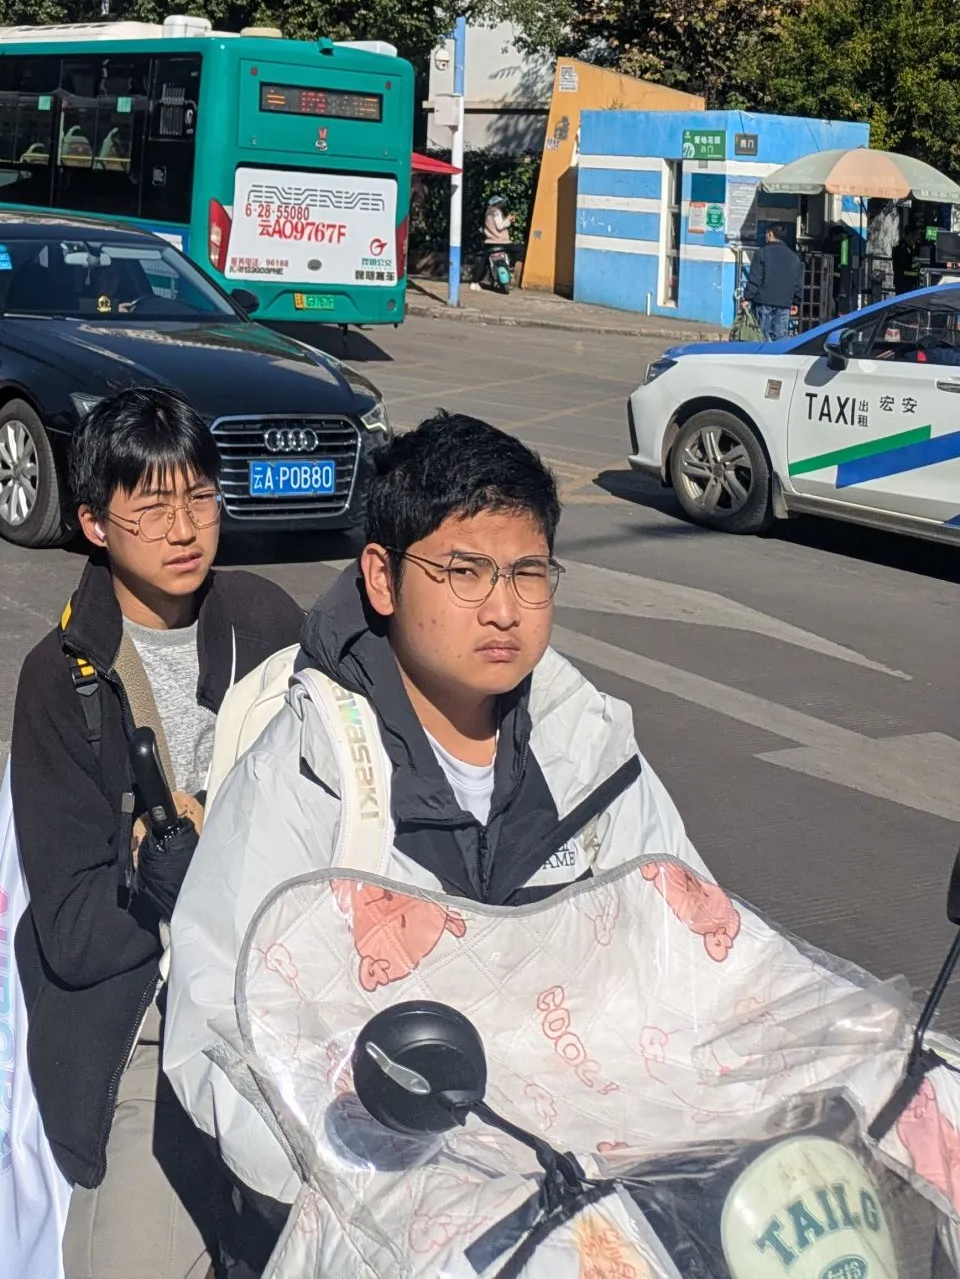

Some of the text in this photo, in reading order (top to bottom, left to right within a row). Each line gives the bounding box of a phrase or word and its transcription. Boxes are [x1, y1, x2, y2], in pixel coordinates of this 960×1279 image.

[805, 392, 857, 426] TAXI
[857, 399, 870, 428] 出租
[879, 395, 918, 414] 宏安
[752, 1181, 882, 1269] TAILG
